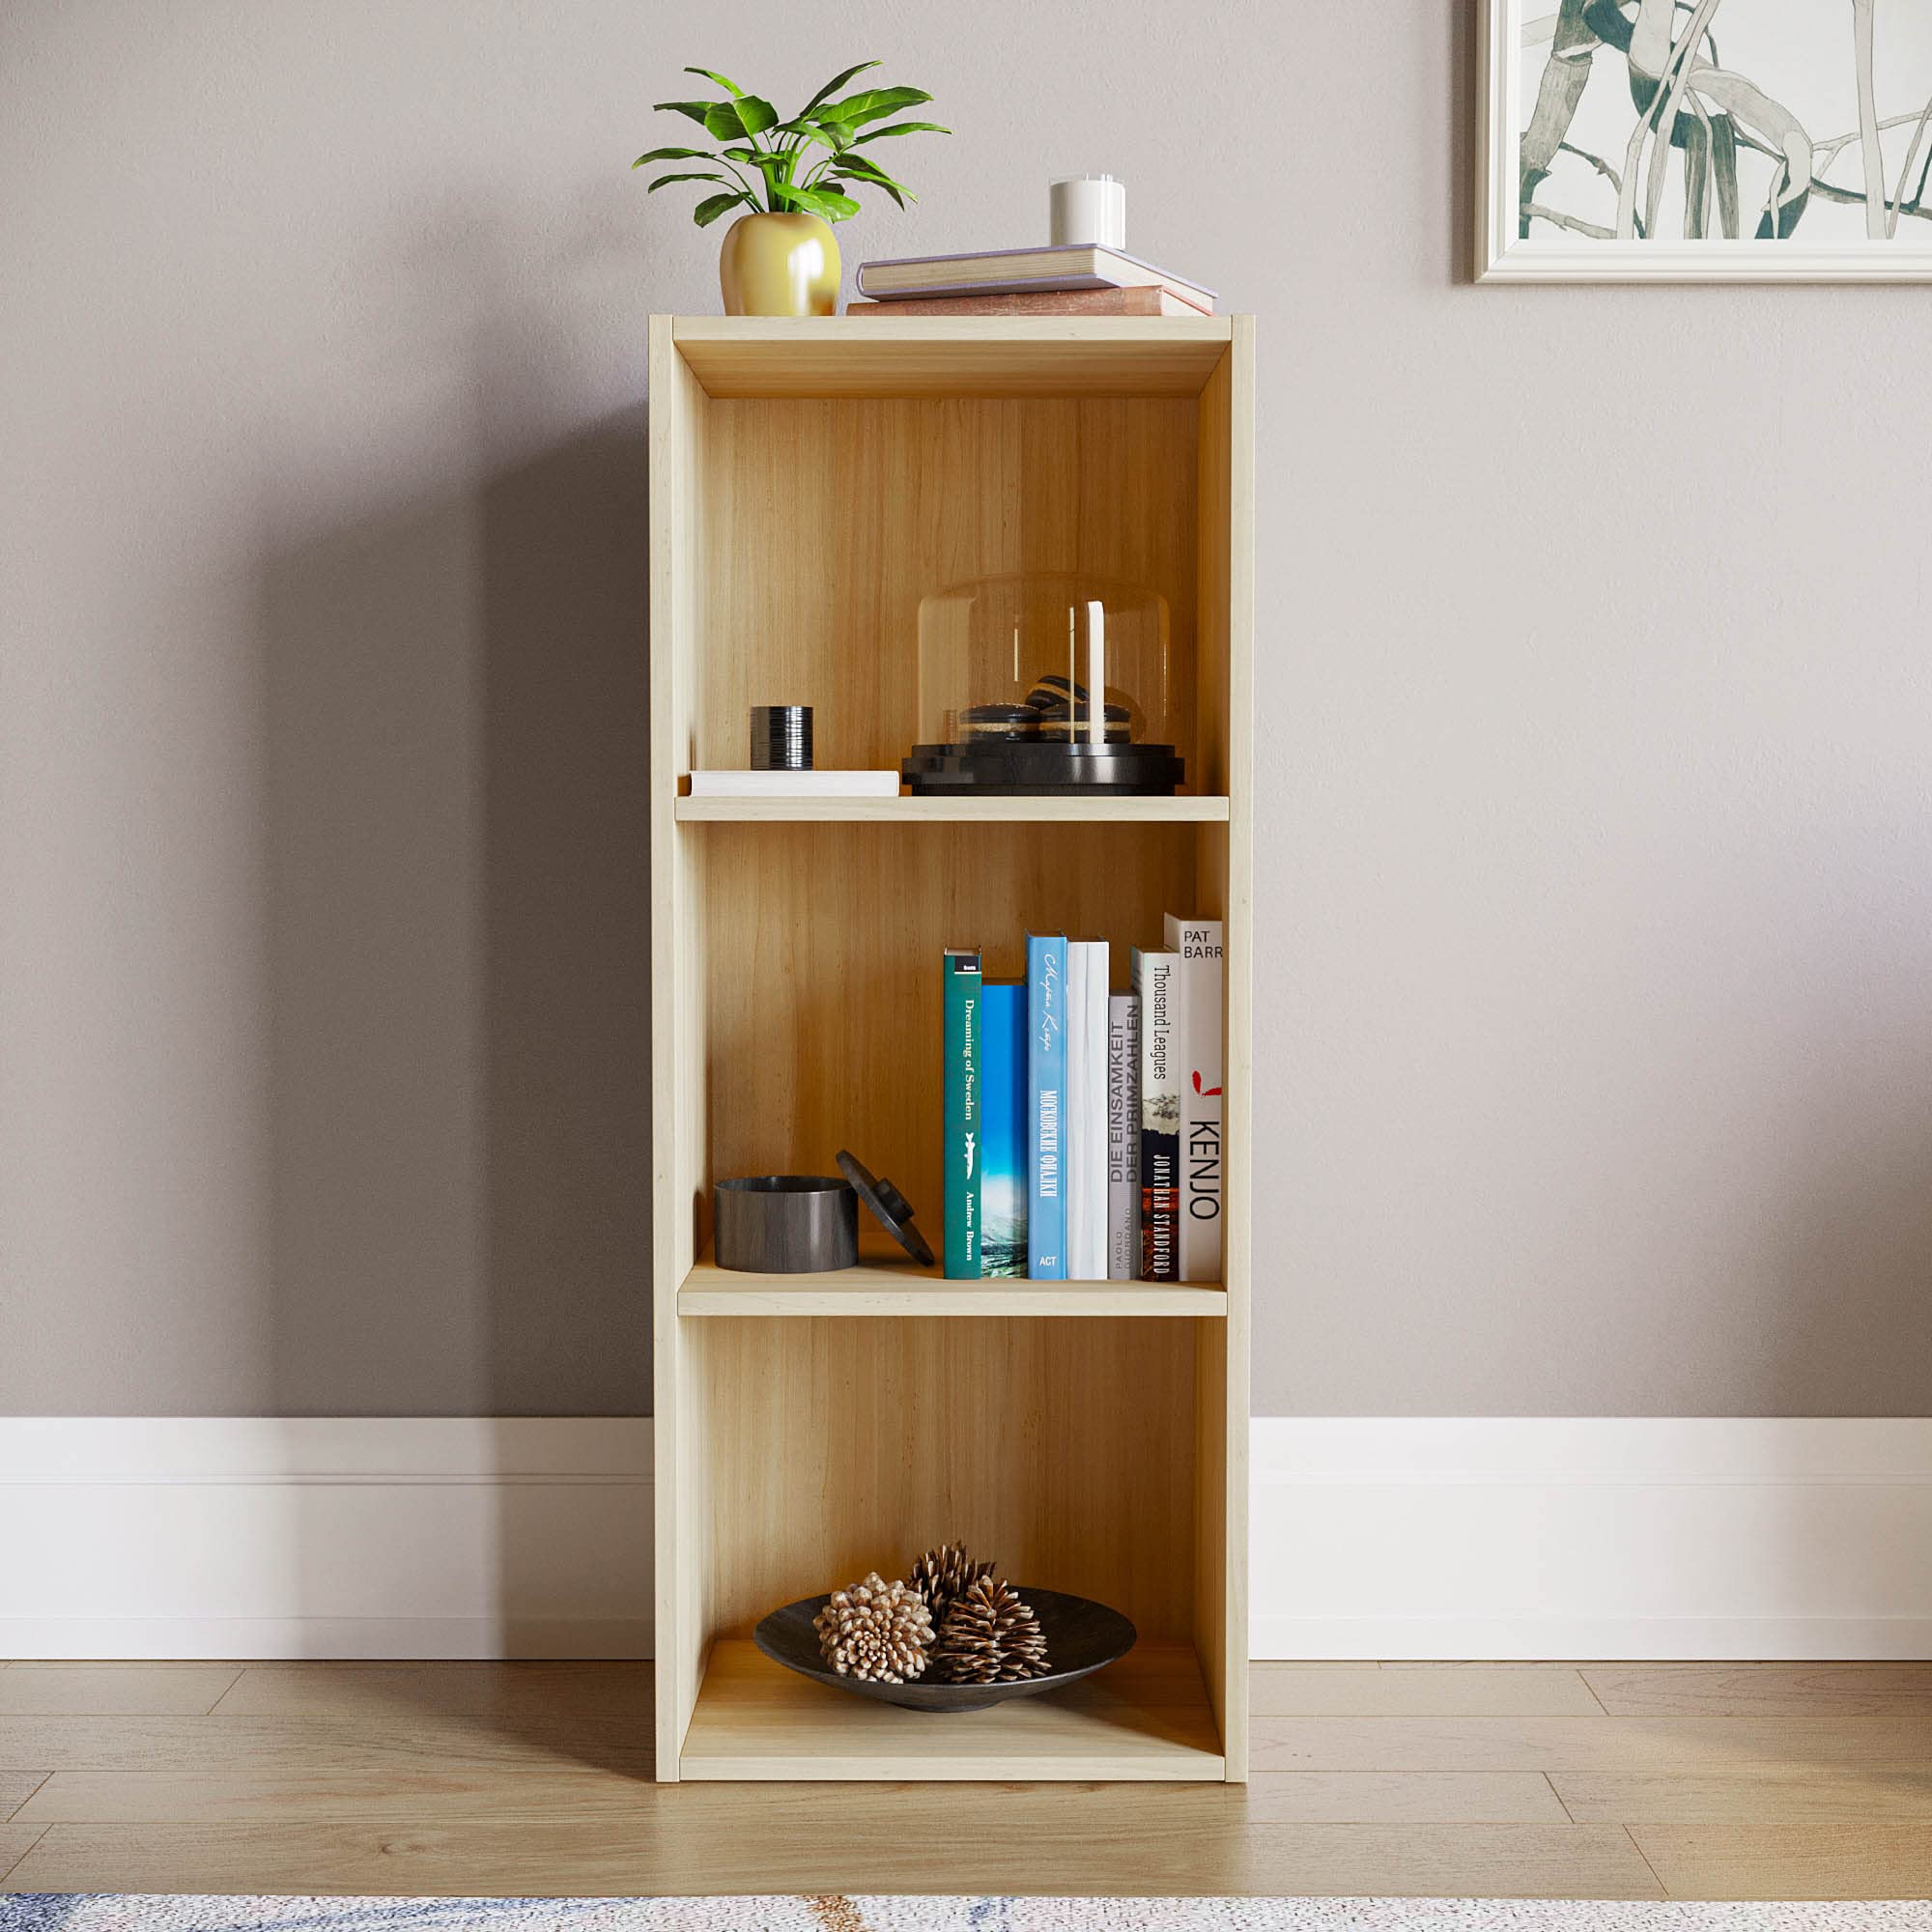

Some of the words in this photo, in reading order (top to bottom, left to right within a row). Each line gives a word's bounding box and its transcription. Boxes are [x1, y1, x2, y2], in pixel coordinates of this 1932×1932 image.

[1183, 930, 1210, 943] PAT
[1183, 946, 1223, 958] BARR
[1153, 965, 1171, 1026] Thousand
[963, 999, 975, 1058] Dreaming
[965, 1060, 975, 1073] of
[1126, 1004, 1139, 1135] PRIMZAHLEN
[1150, 1029, 1170, 1080] Leagues
[965, 1074, 975, 1121] Sweden
[1111, 1021, 1122, 1144] EINSAMKEIT
[1039, 1090, 1058, 1152] МОСКОВСКИЕ
[1039, 1154, 1058, 1198] ФИАЛКИ
[1111, 1151, 1122, 1183] DIE
[1126, 1142, 1138, 1183] DER
[1152, 1154, 1171, 1208] JONATHAN
[1189, 1121, 1220, 1220] KENJO
[966, 1191, 975, 1228] Andrew
[966, 1231, 975, 1261] Brown
[1152, 1213, 1171, 1274] STANDFORD
